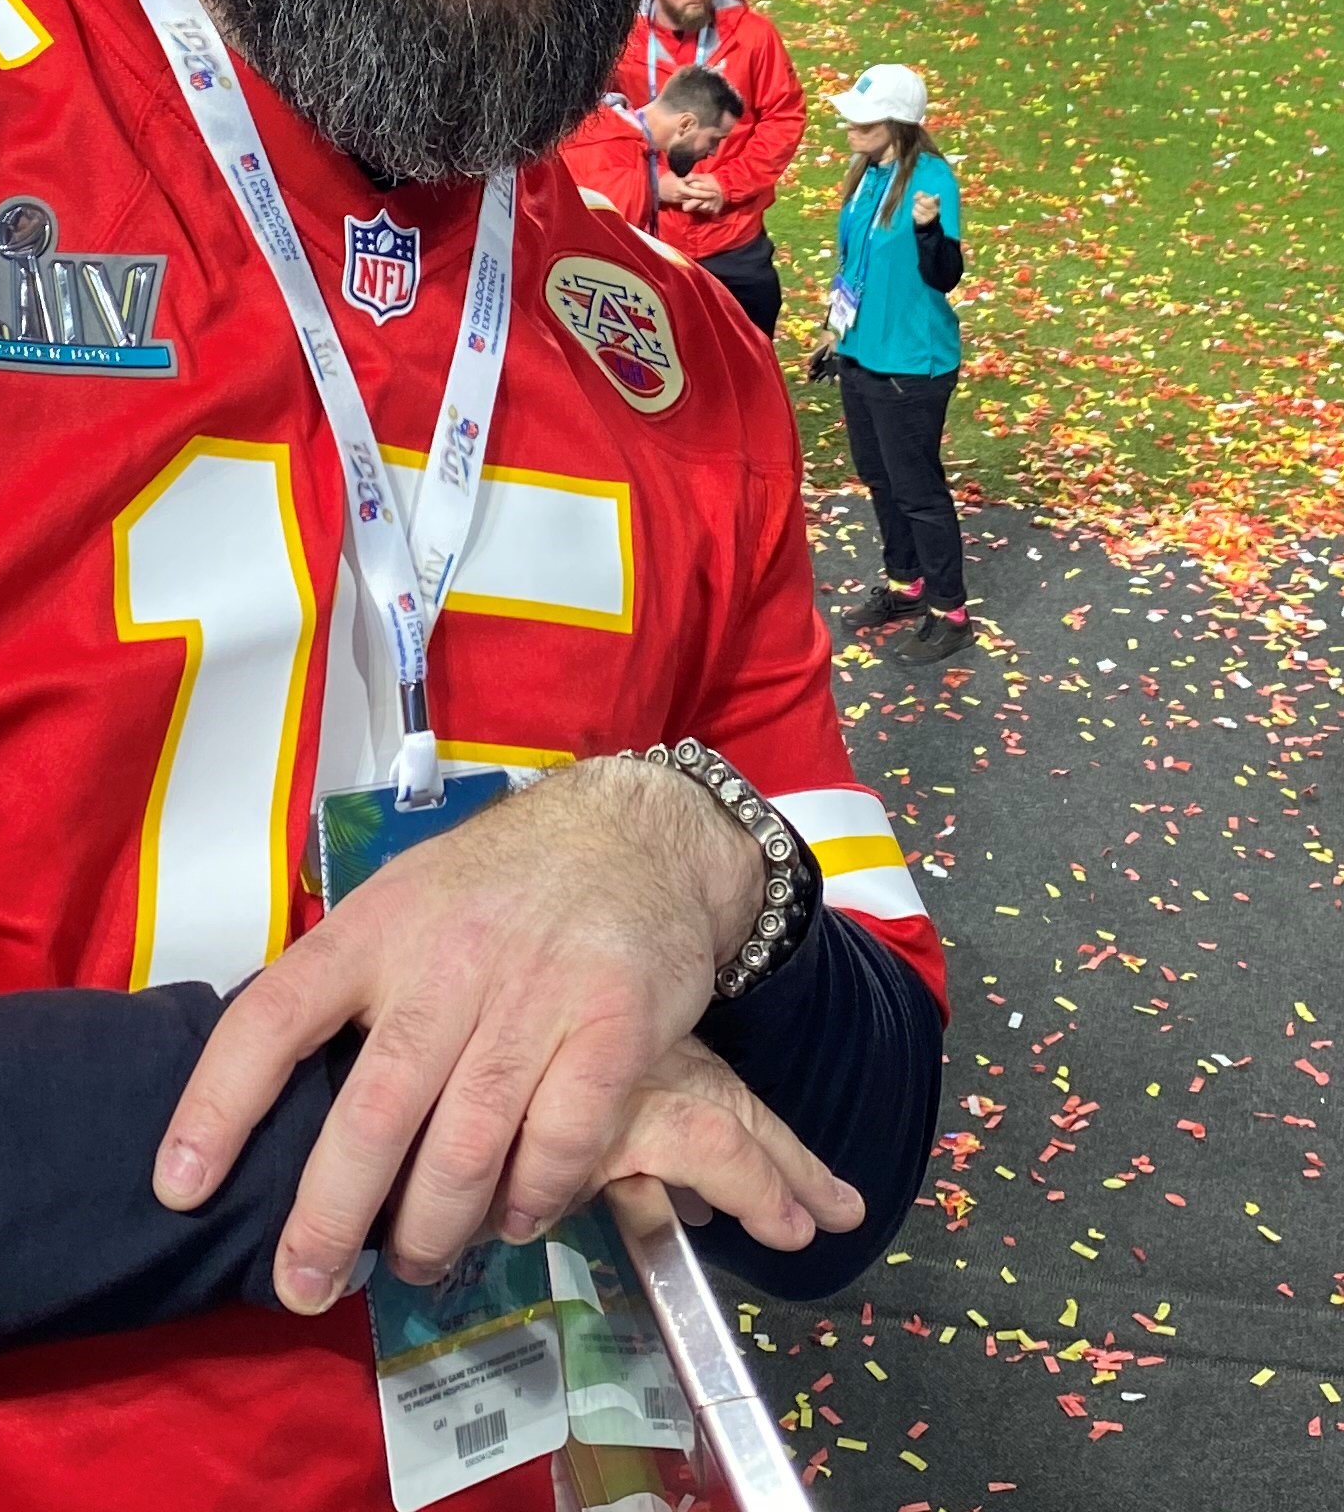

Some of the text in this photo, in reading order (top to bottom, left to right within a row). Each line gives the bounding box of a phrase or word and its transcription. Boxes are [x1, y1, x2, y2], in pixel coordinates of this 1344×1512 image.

[249, 181, 291, 262] EXPERIENCES
[356, 256, 410, 305] NFL
[474, 252, 491, 307] LOCATION
[481, 258, 499, 331] EXPERIENCES
[408, 622, 424, 679] EXPERIE
